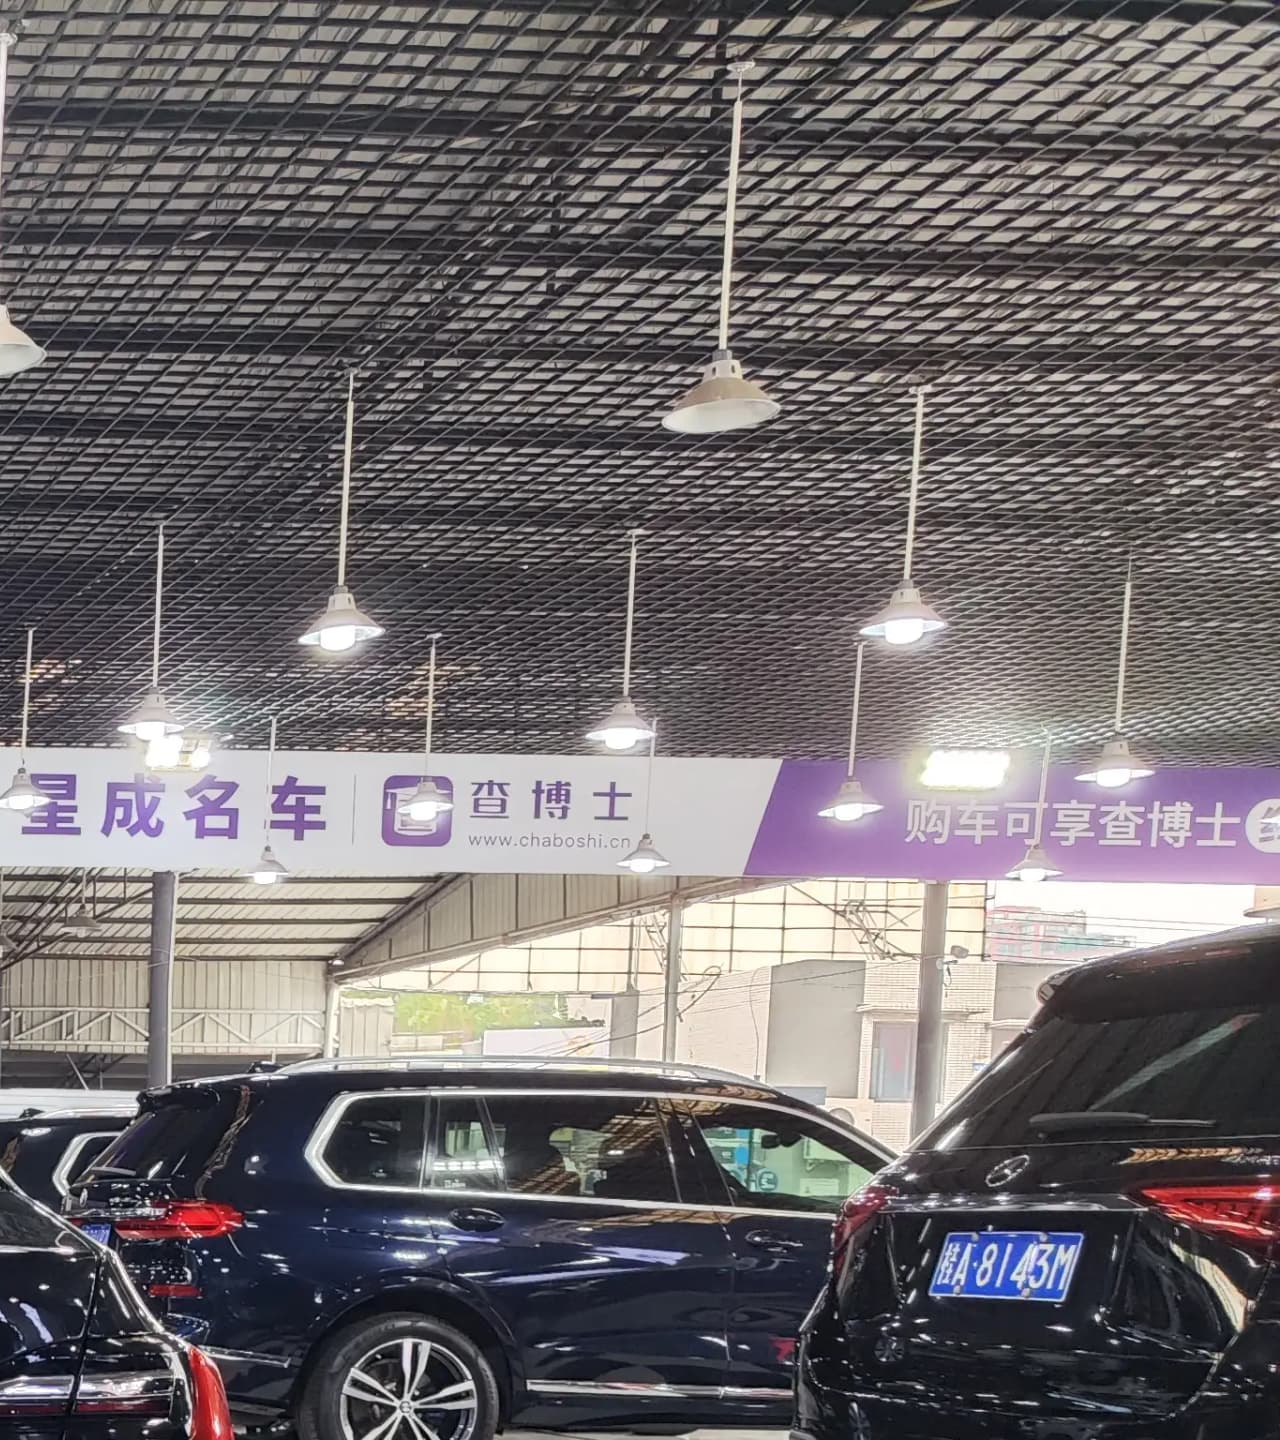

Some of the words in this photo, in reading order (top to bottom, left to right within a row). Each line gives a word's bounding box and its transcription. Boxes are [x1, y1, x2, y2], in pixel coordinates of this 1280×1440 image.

[21, 773, 327, 841] 星成名车
[469, 779, 633, 821] 查博士
[468, 831, 632, 850] www.chaboshi.cn
[905, 799, 1241, 848] 购车可享查博士
